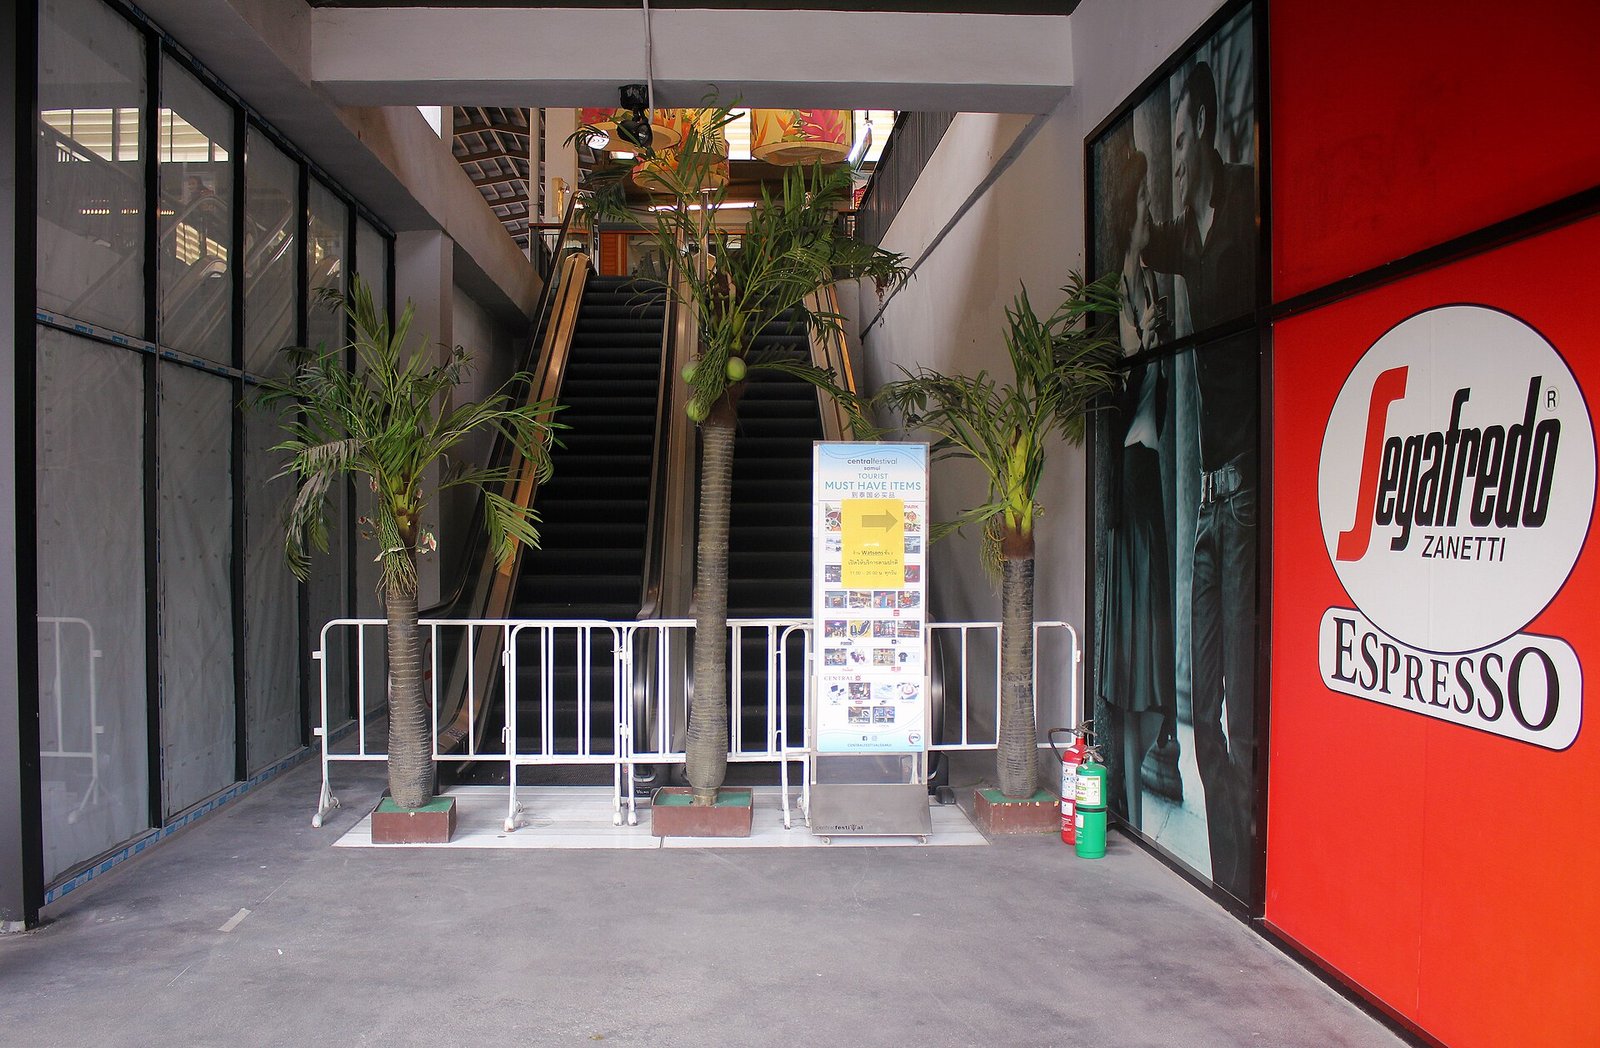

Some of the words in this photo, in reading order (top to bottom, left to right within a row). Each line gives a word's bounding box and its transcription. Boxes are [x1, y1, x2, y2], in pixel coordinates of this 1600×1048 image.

[847, 457, 898, 465] centralfestival
[1336, 365, 1561, 562] Segafredo
[825, 481, 854, 490] MUST
[857, 481, 887, 490] HAVE
[890, 481, 922, 491] ITEMS
[1421, 535, 1507, 562] ZANETTI
[1331, 617, 1561, 732] ESPRESSO
